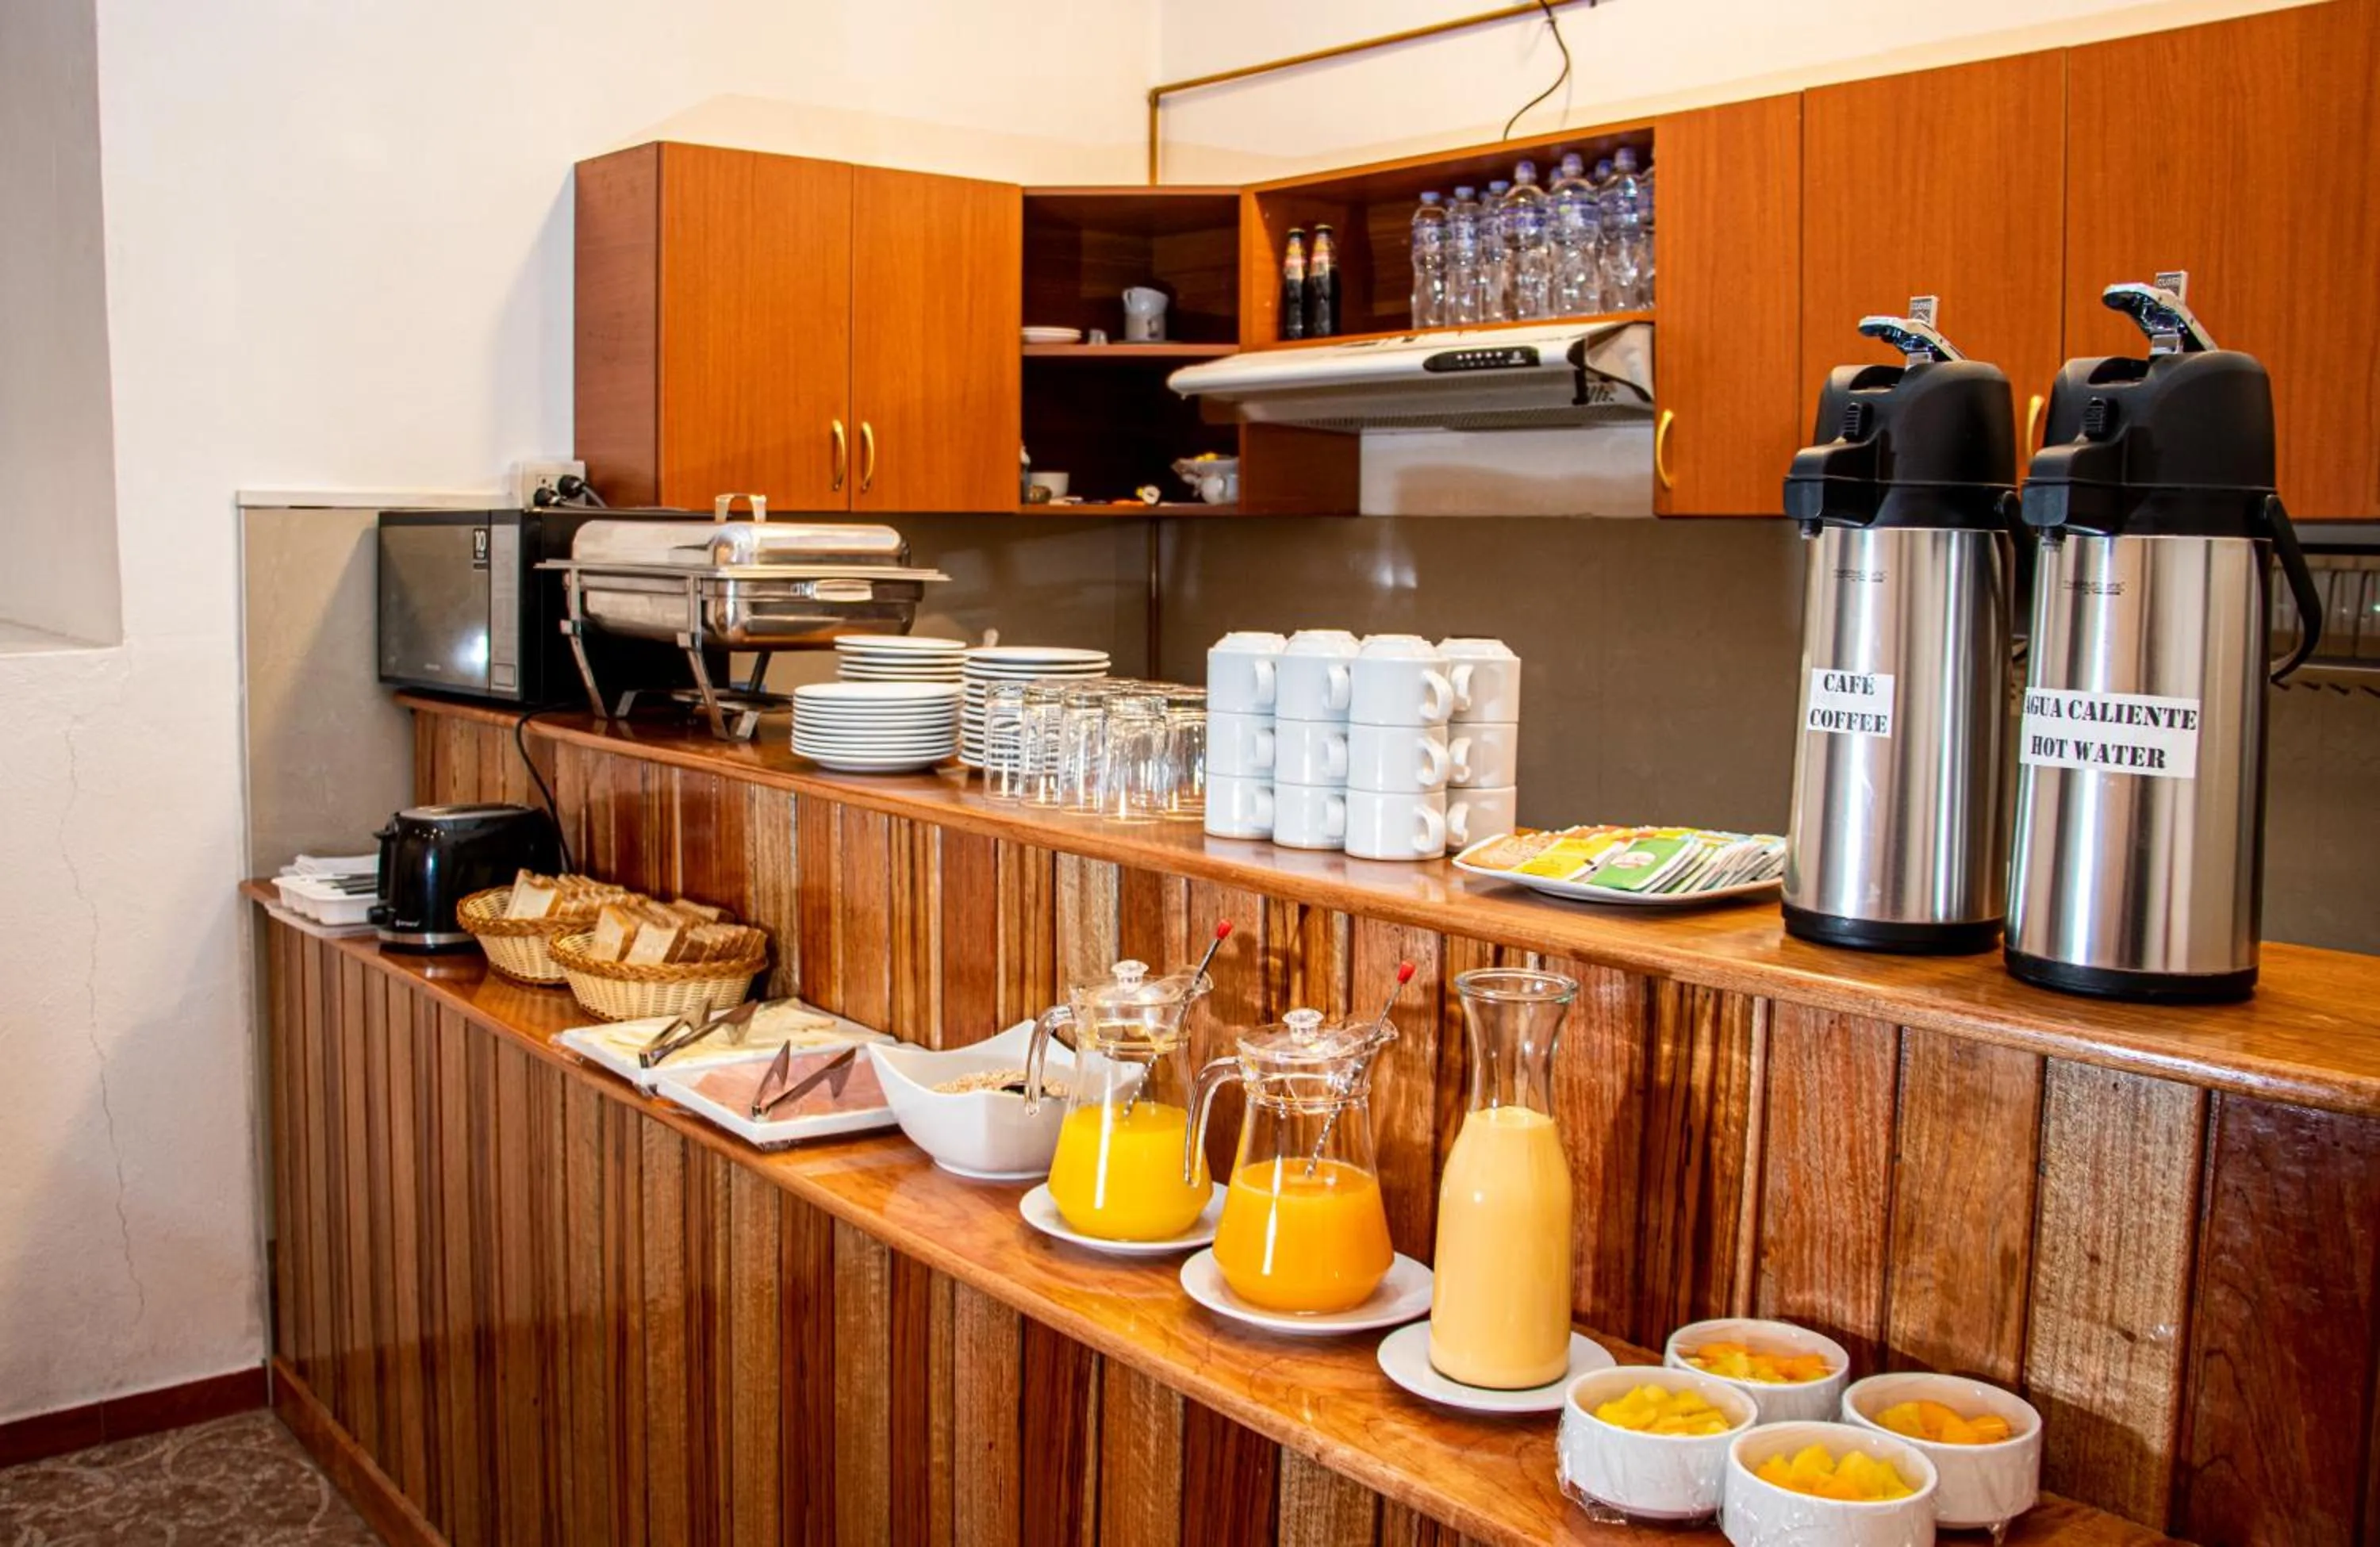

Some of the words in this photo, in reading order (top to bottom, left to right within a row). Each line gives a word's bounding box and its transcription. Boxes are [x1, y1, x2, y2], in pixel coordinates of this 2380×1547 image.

[1823, 672, 1875, 696] CAFÉ
[1810, 708, 1888, 734] COFFEE
[2025, 695, 2063, 718] AGUA
[2068, 699, 2197, 730] CALIENTE
[2030, 735, 2068, 759] HOT
[2074, 739, 2167, 769] WATER
